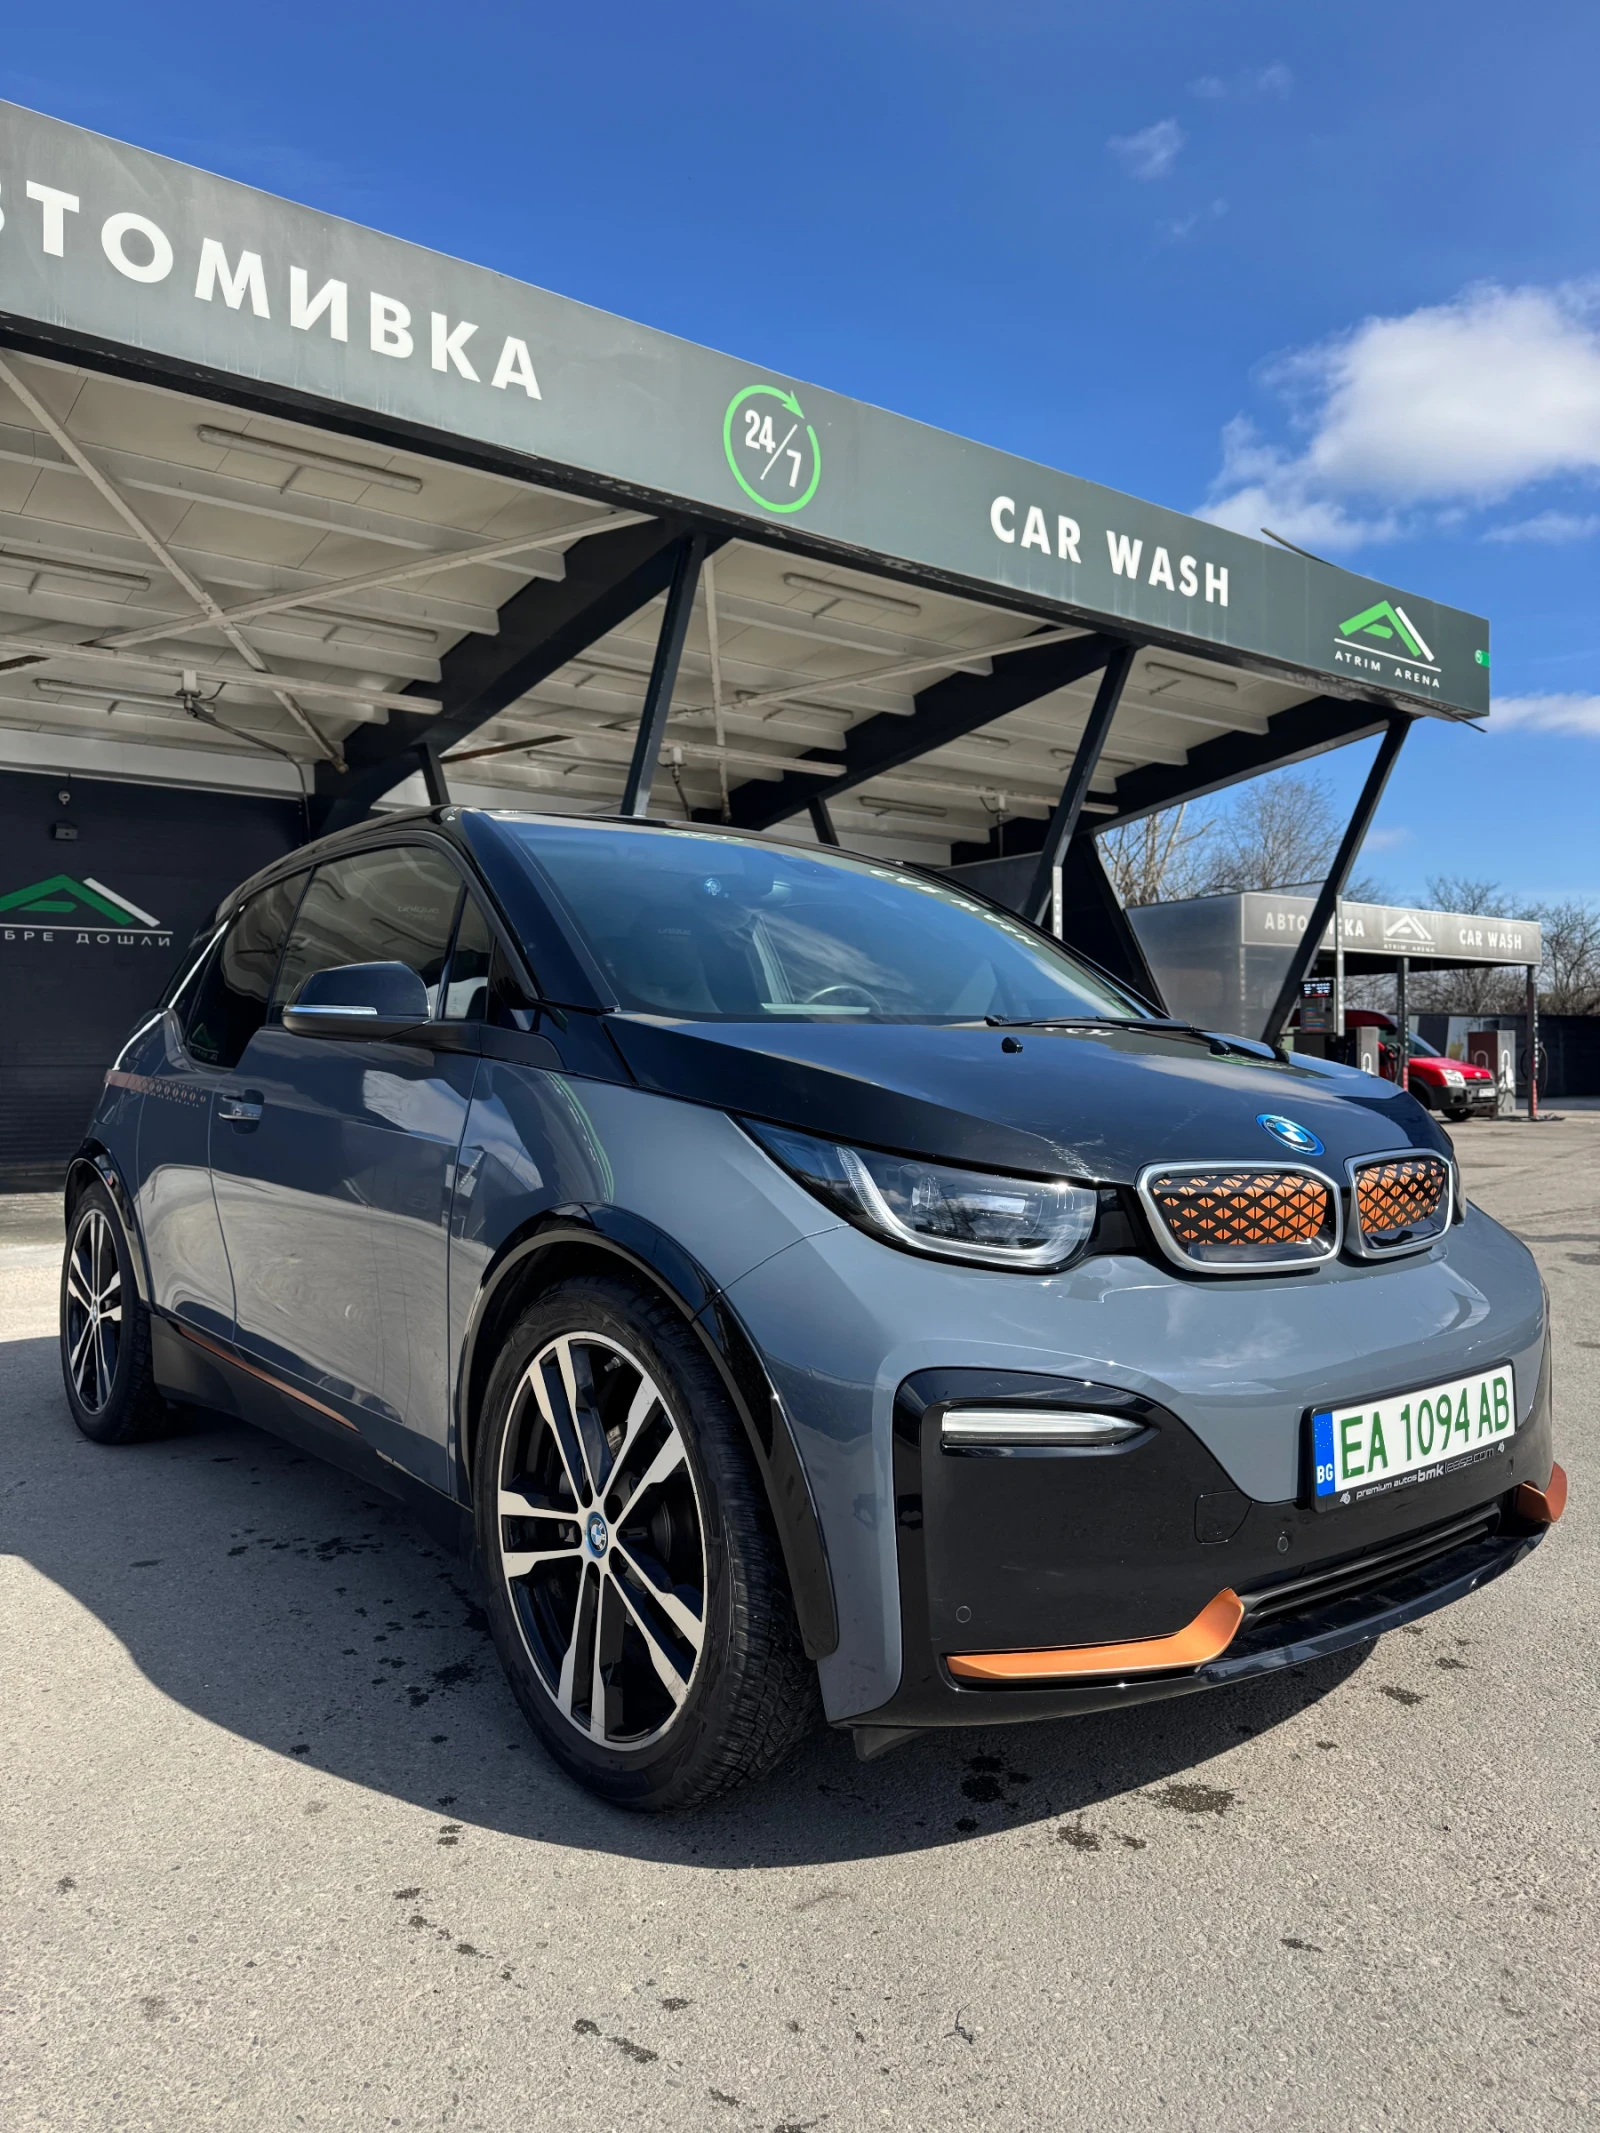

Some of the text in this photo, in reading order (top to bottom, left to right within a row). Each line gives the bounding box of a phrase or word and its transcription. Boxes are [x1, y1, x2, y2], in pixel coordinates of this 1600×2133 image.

[0, 180, 541, 400] ТОМИВКА
[744, 409, 802, 488] 24/7
[990, 496, 1228, 607] CAR WASH
[1335, 650, 1441, 688] ATRIM ARENA
[76, 932, 171, 947] ДОШЛИ
[1264, 911, 1365, 938] АВТОКА
[1459, 928, 1523, 950] CAR WASH
[1341, 1376, 1510, 1480] EA 1094 AB
[1316, 1464, 1334, 1484] BG
[1356, 1482, 1393, 1500] premium
[1393, 1474, 1418, 1487] autos
